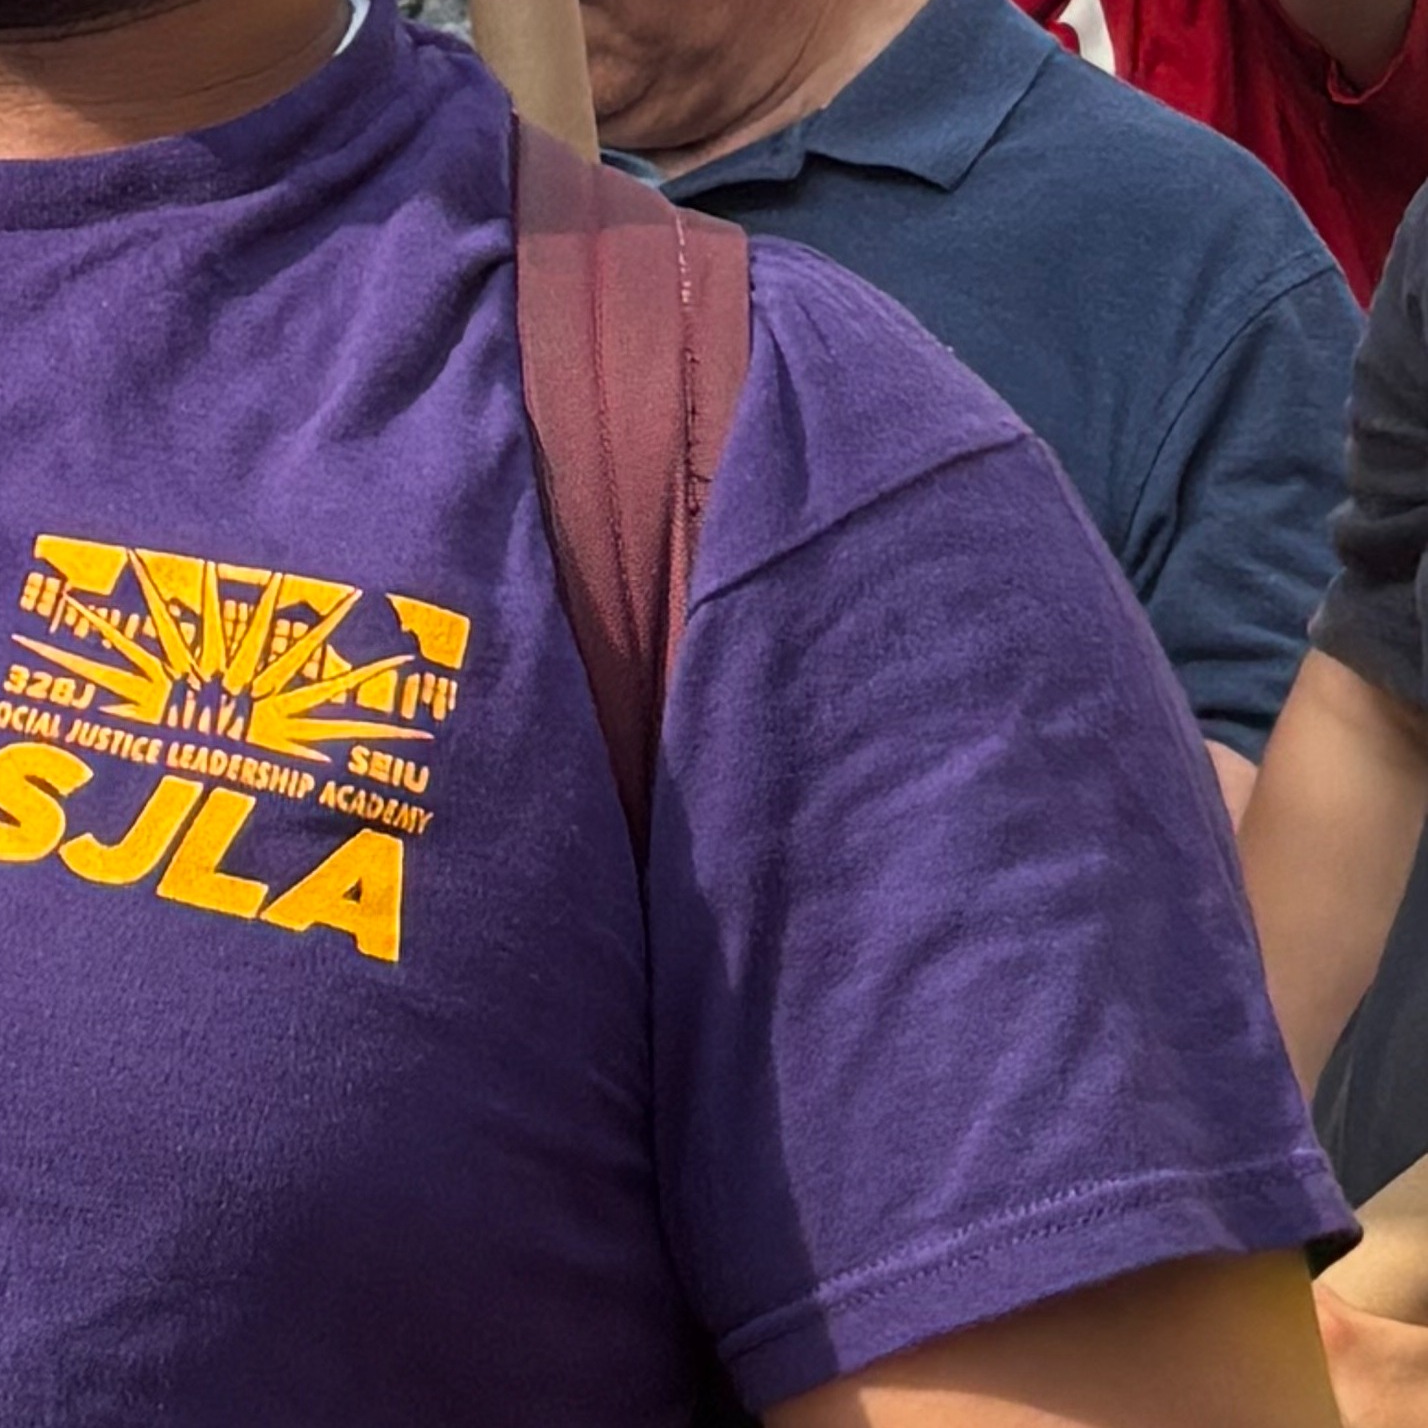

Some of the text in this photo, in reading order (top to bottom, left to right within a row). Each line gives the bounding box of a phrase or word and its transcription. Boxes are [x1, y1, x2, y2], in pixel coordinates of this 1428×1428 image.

[2, 663, 430, 794] 32BJ SEIU
[64, 718, 164, 765] JUSTICE
[166, 741, 316, 800] LEADERSHIP
[318, 780, 434, 834] ACADEMY
